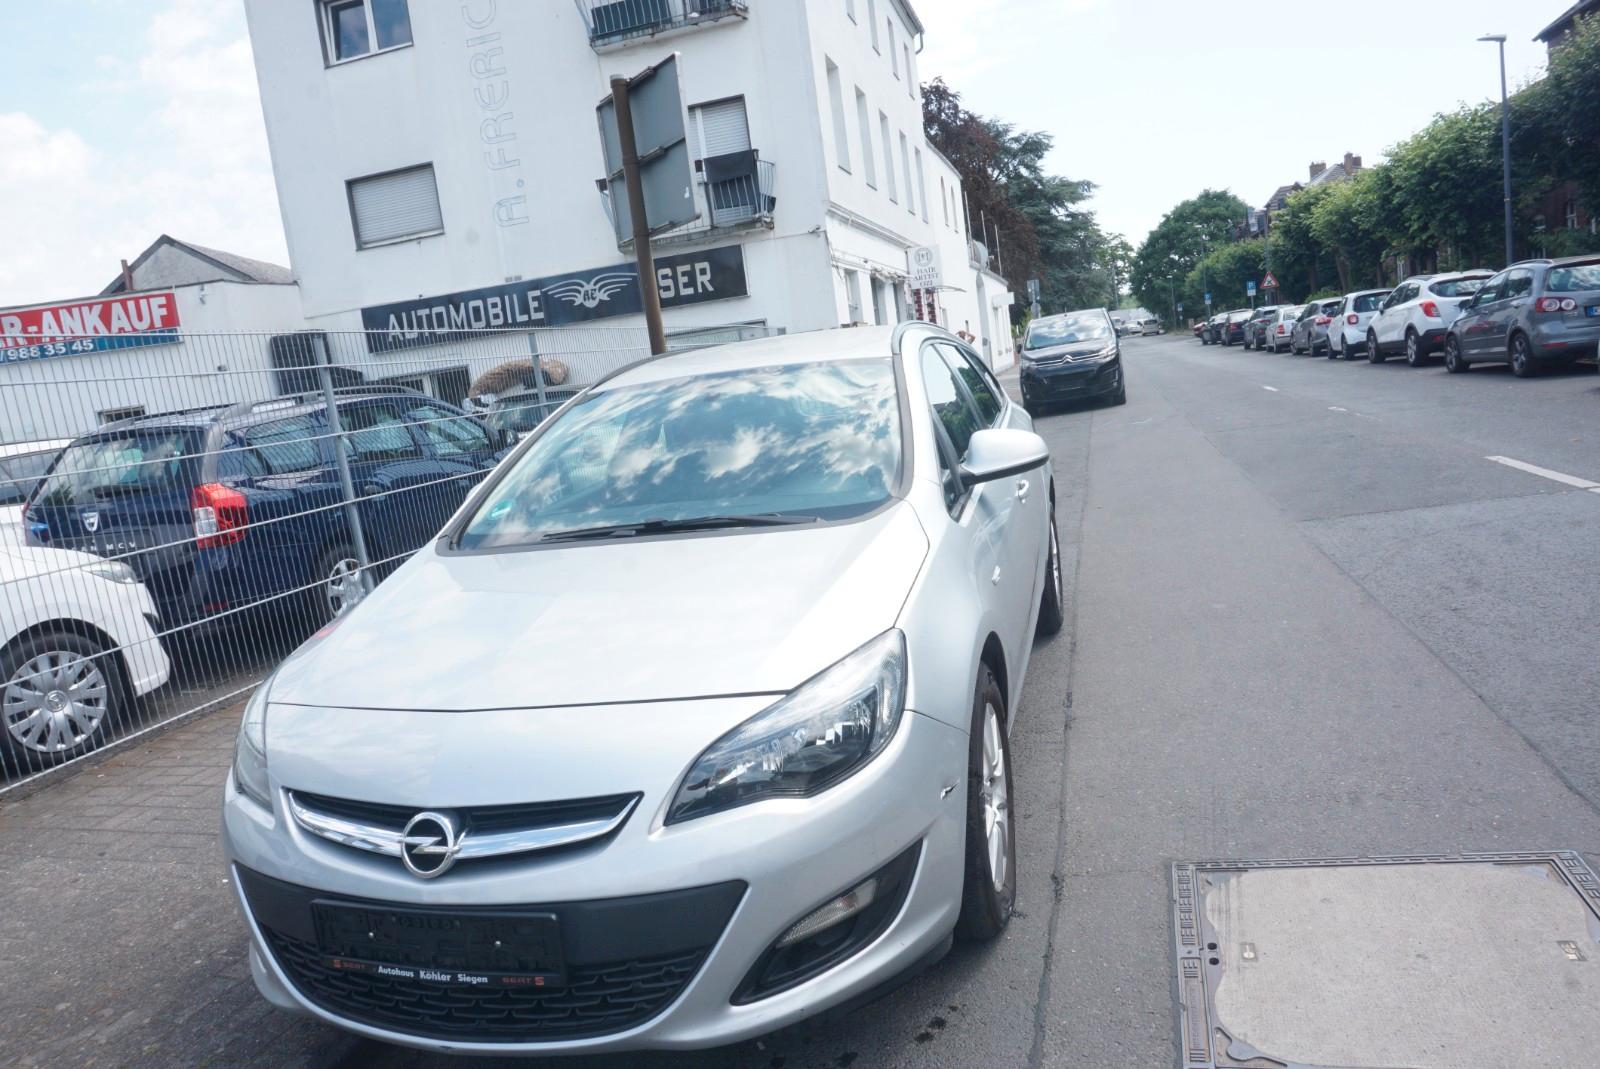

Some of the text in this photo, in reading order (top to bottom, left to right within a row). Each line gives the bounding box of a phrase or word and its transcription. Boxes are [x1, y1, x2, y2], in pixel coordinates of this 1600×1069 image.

[914, 272, 939, 281] ARTIST
[916, 266, 937, 274] HAIR
[388, 289, 545, 342] AUTOMOBILE
[657, 261, 714, 299] SER
[0, 297, 168, 348] R-ANKAUF
[44, 341, 66, 356] 35
[72, 339, 94, 352] 45
[378, 965, 415, 978] Autohaus
[420, 969, 451, 981] Köhler
[457, 973, 489, 985] Siegen
